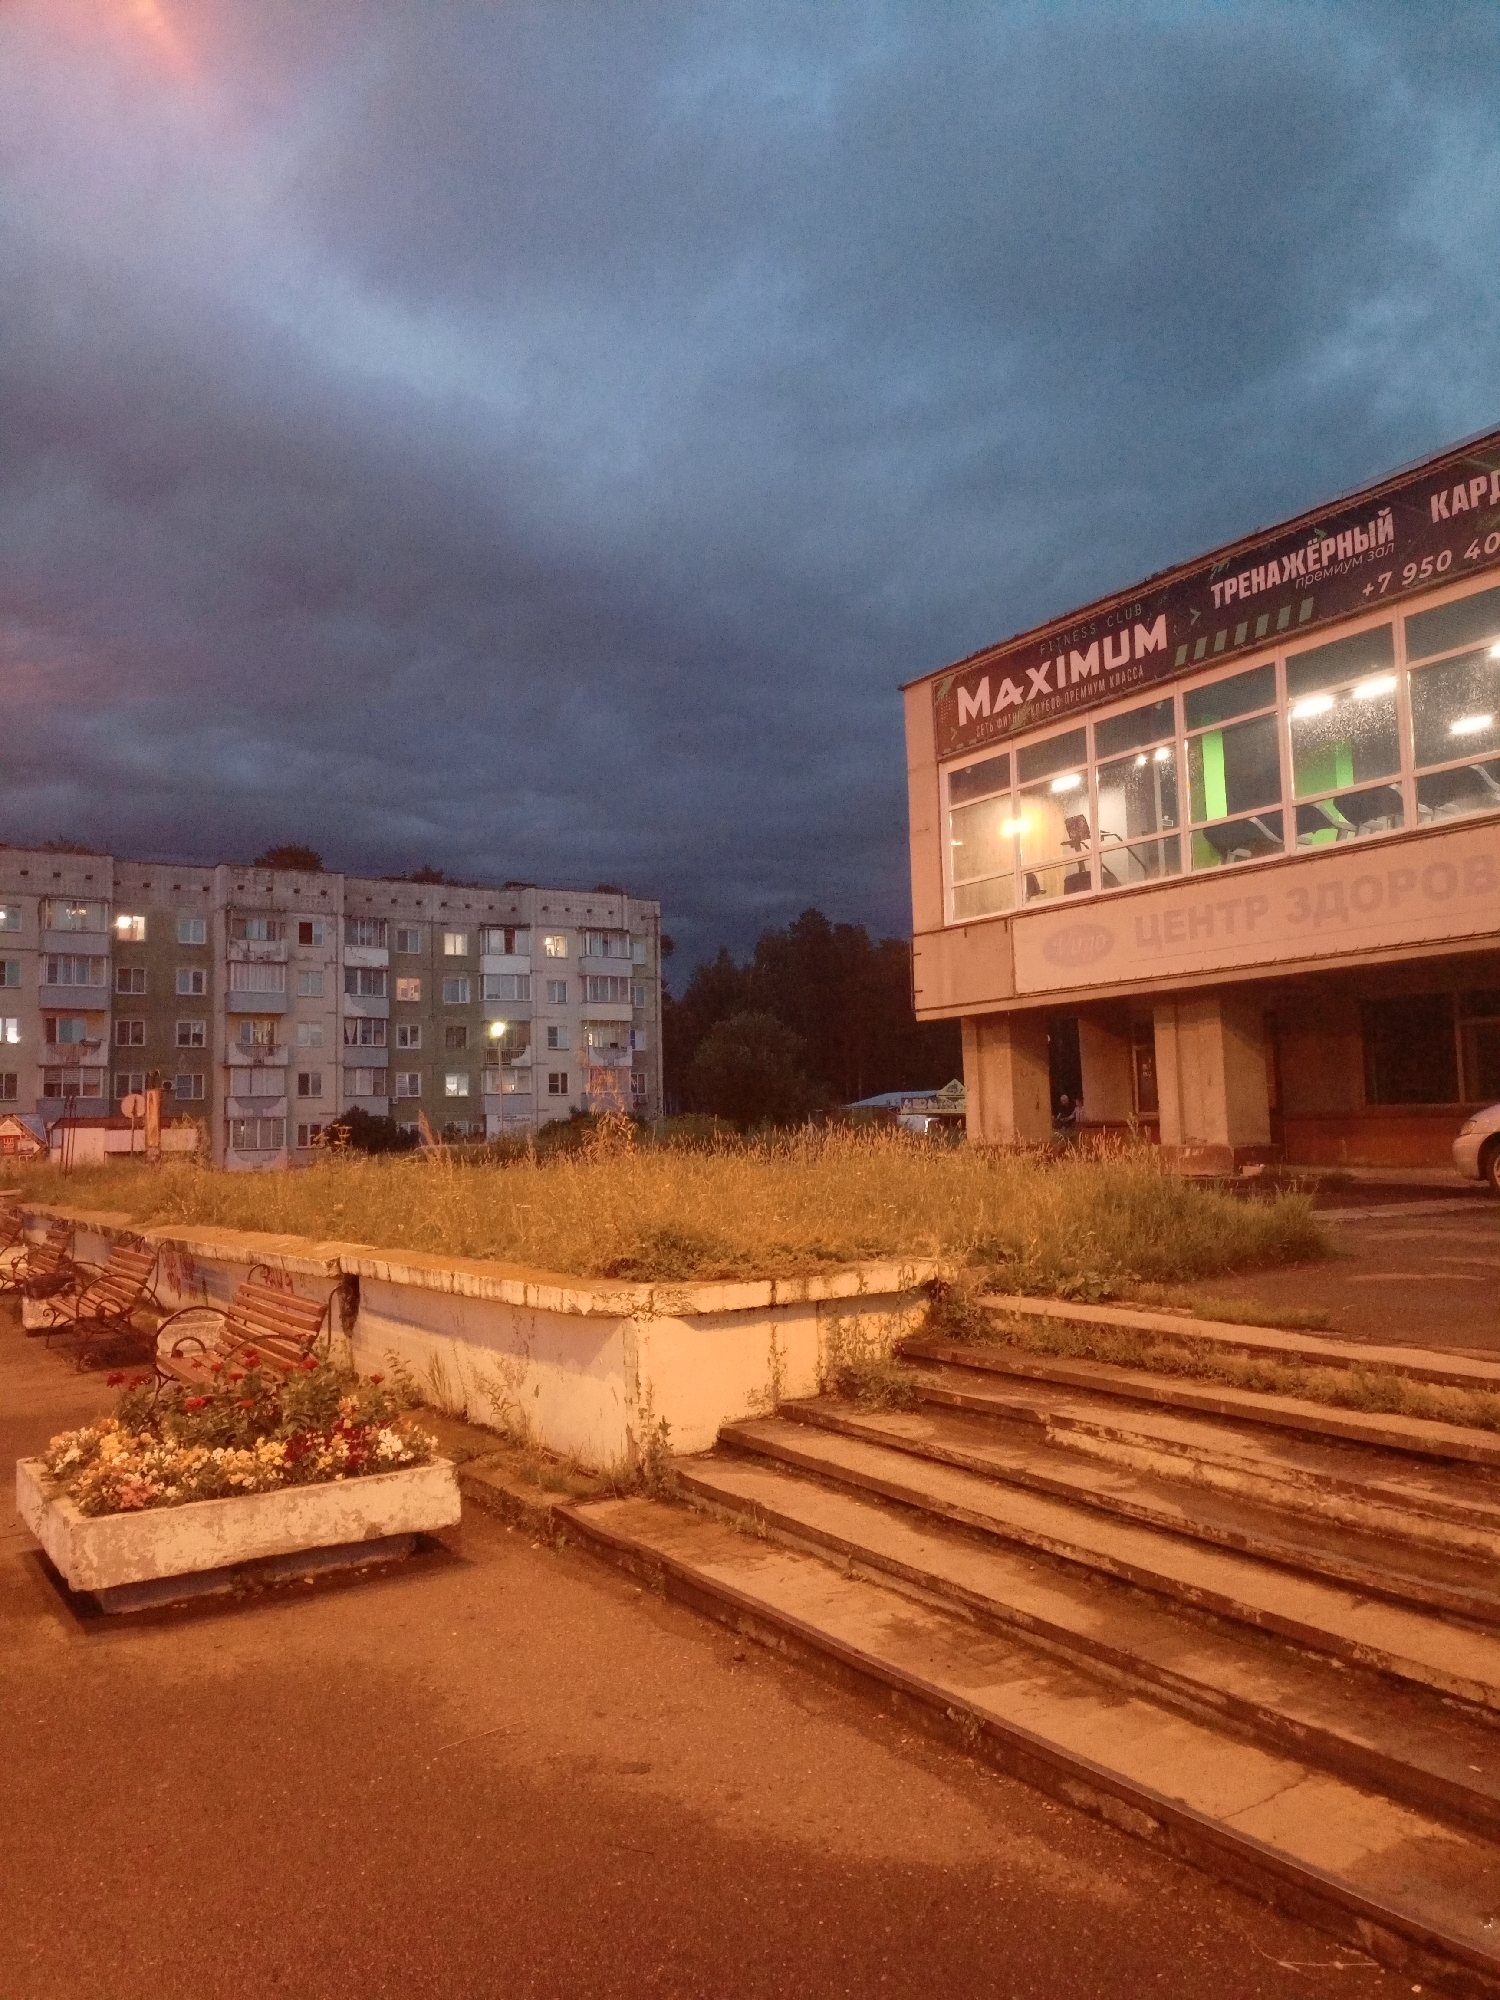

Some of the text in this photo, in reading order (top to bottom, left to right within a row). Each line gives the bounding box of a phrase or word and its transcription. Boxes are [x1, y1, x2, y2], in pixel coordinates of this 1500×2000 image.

[1210, 506, 1395, 610] ТРЕНАЖЁРНЫЙ
[1295, 542, 1395, 590] премиум зал
[1362, 531, 1500, 597] +7 950 40
[1040, 603, 1142, 656] FITNESS CLUB
[956, 613, 1169, 728] MAXIMUM
[976, 721, 994, 738] СЕТЬ
[1030, 695, 1061, 721] КЛУБОВ
[1064, 678, 1106, 705] ПРЕМИУМ
[1109, 664, 1144, 689] КЛАССА
[1134, 853, 1500, 950] ЦЕНТР ЗДОРОВ
